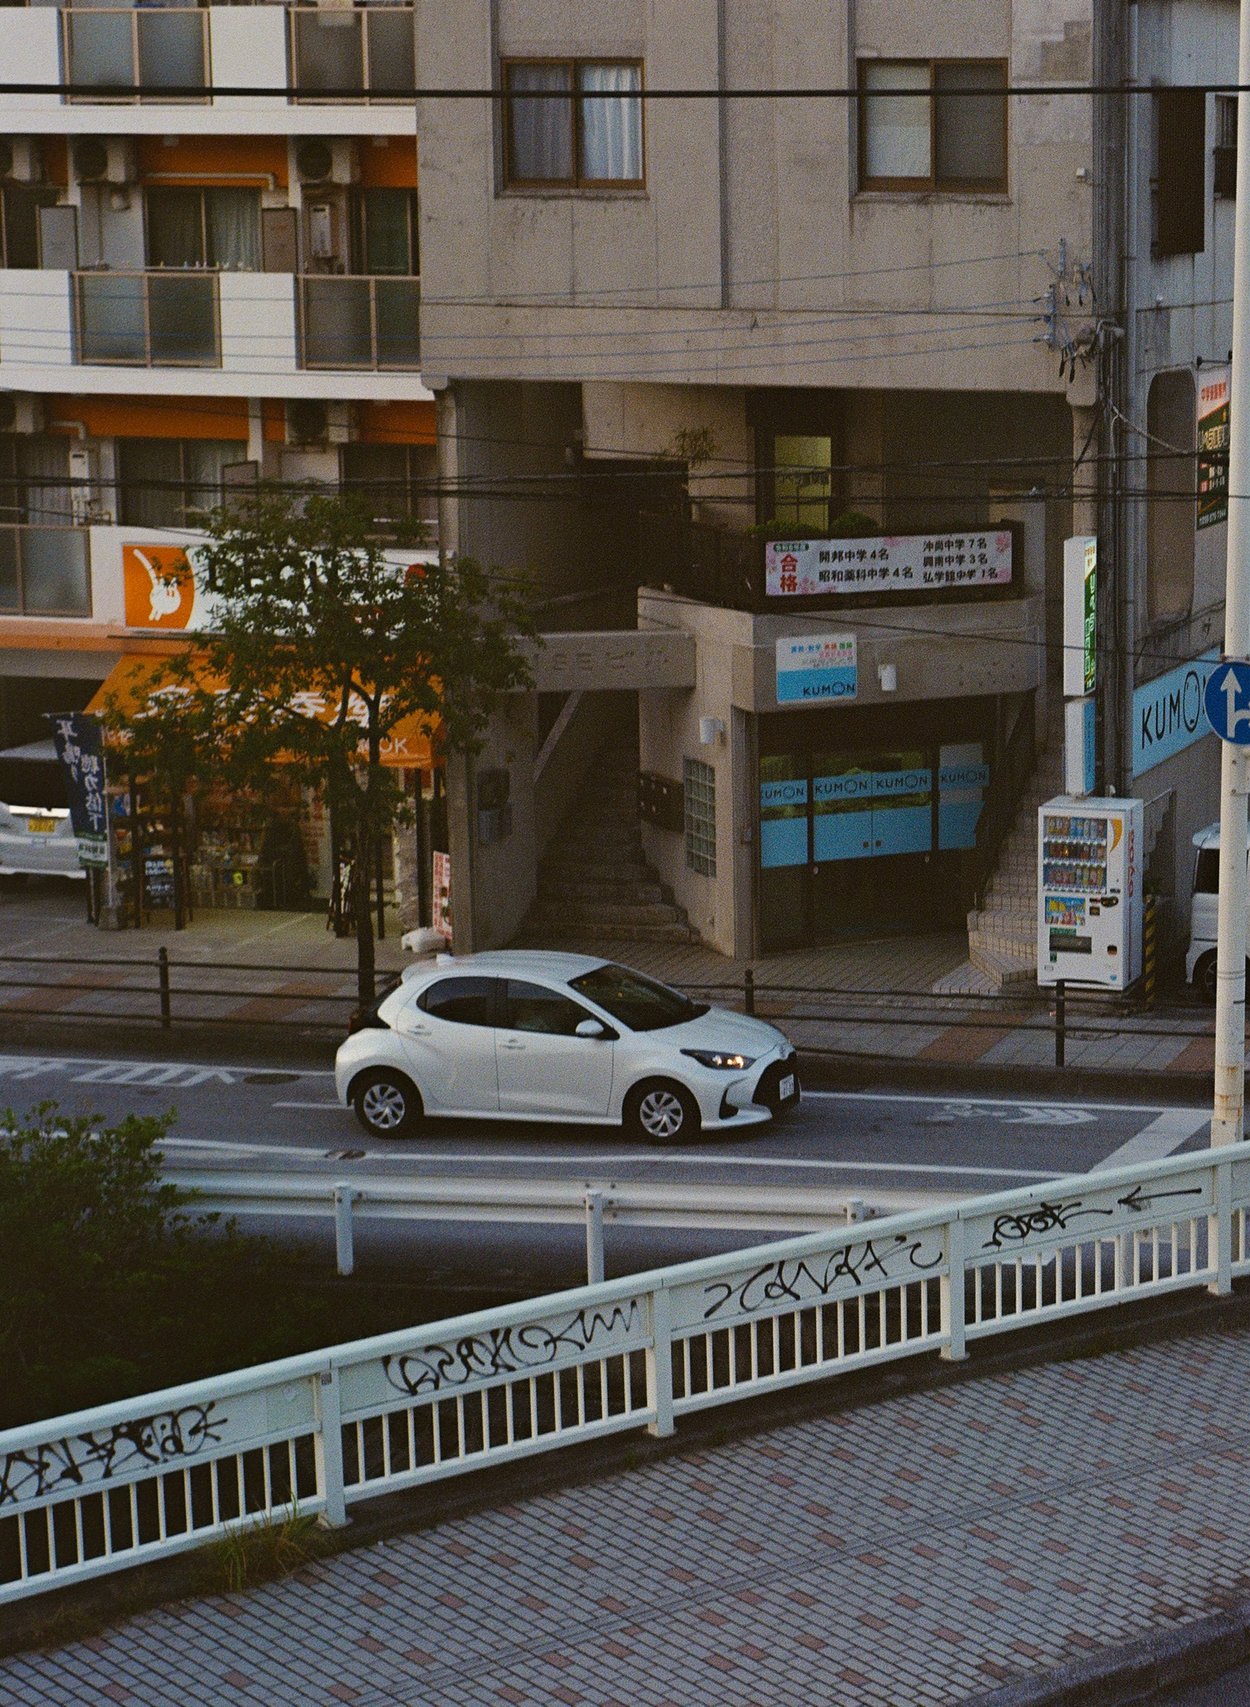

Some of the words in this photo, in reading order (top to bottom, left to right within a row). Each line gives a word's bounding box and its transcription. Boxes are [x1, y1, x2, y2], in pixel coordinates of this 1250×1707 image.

[780, 553, 798, 593] 合格
[803, 681, 855, 696] KUMON
[876, 774, 928, 789] KUMON
[941, 769, 986, 784] KUMON
[815, 779, 869, 794] KUMON
